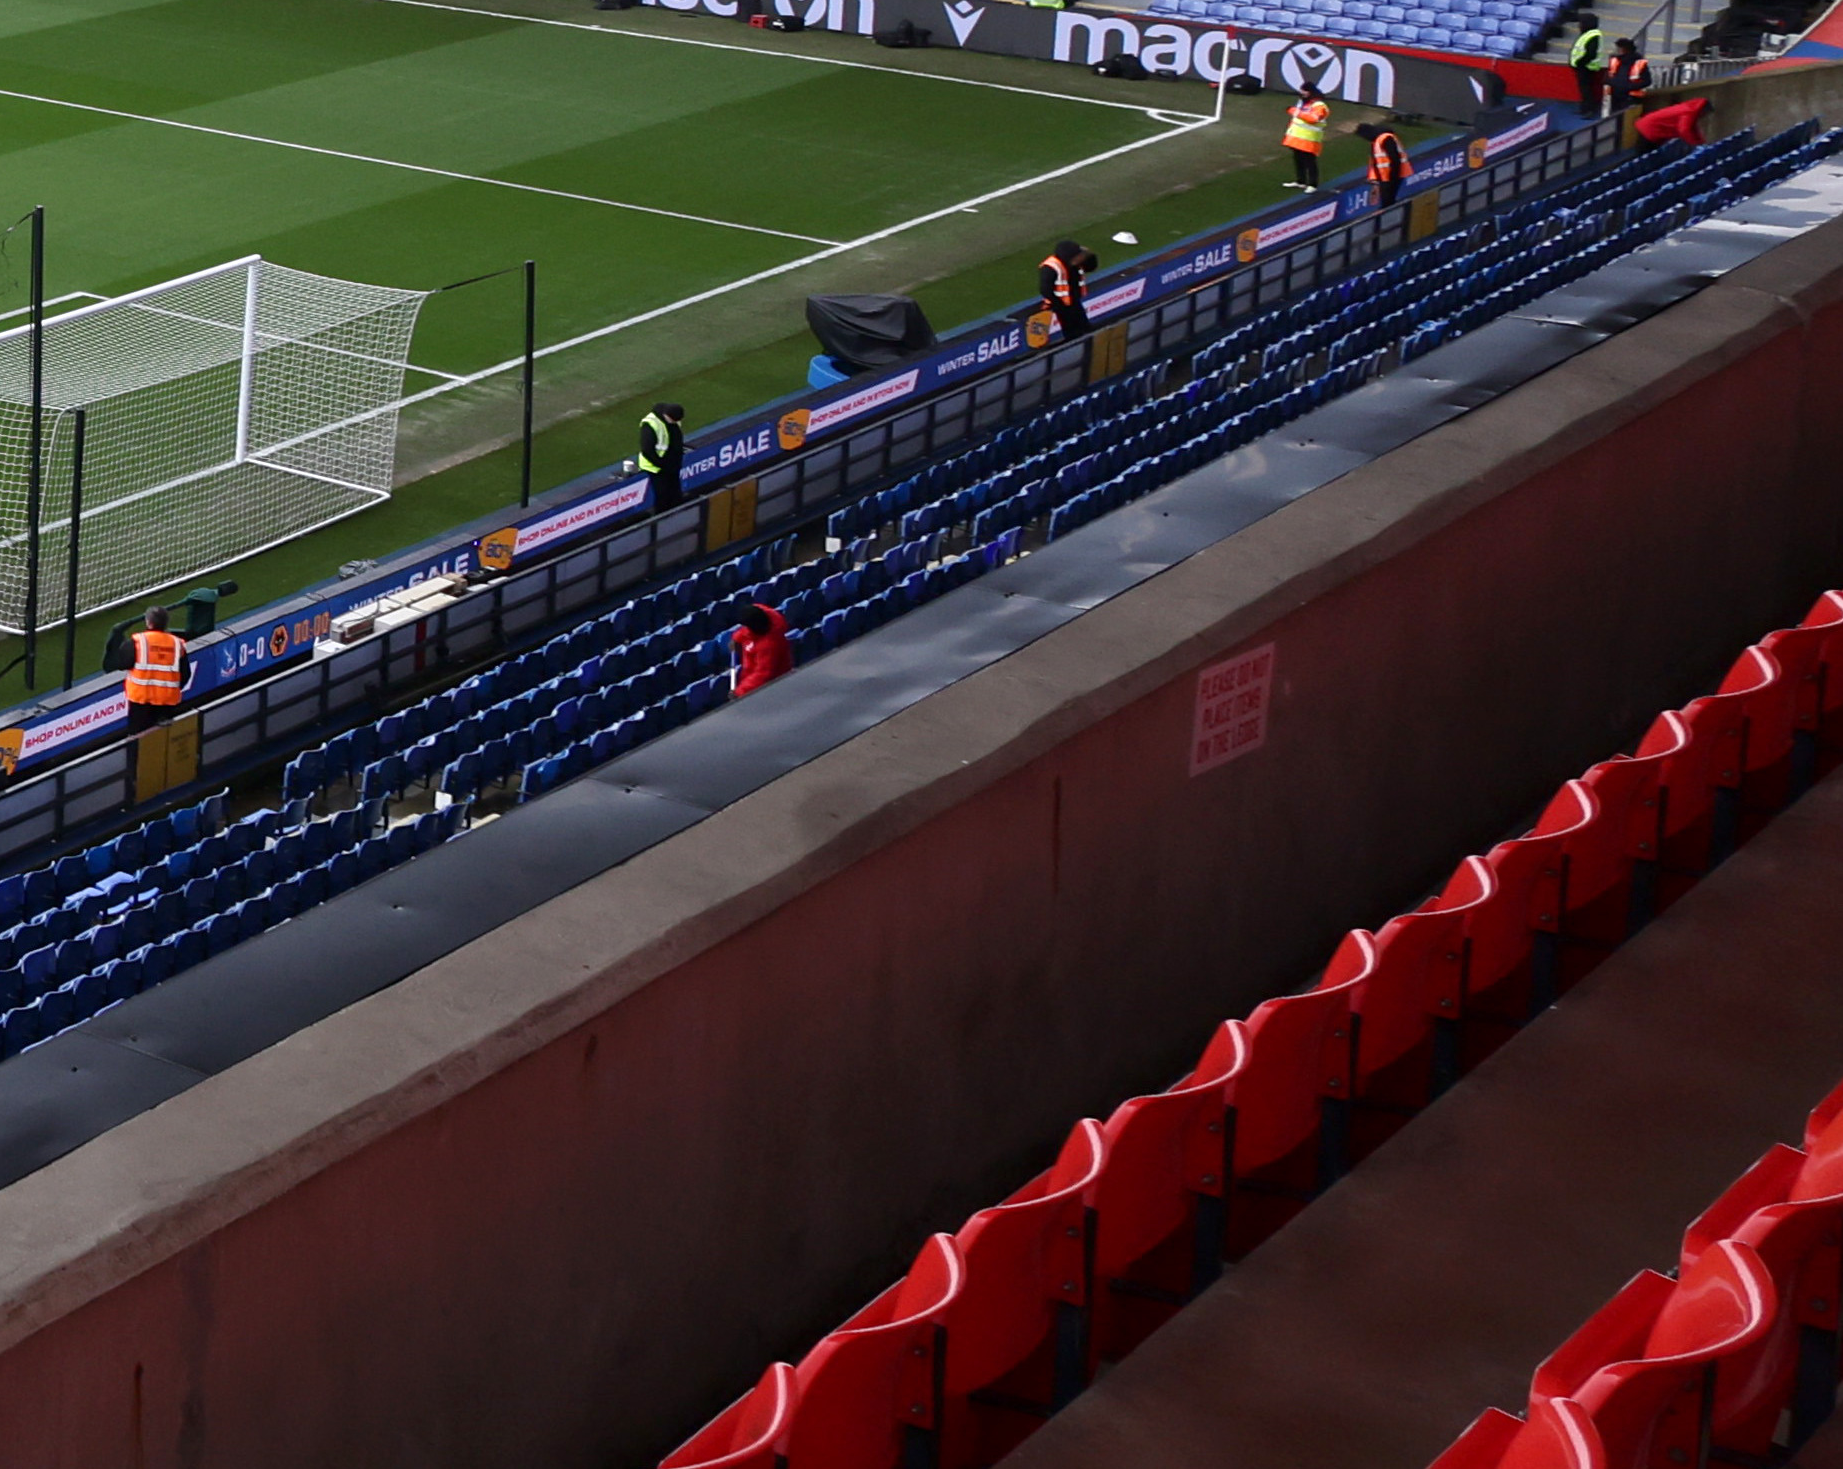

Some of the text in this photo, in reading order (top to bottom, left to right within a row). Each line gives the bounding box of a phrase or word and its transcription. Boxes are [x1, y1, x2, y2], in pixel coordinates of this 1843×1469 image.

[1052, 10, 1395, 108] macron
[1194, 243, 1231, 274] SALE
[937, 328, 1021, 376] WINTER SALE
[680, 456, 716, 480] INTER
[719, 429, 771, 468] SALE
[293, 611, 330, 646] 00:00
[239, 636, 265, 667] 0-0
[1201, 666, 1235, 700] PLEASE
[24, 700, 126, 749] SHOP ONLINE AND IN
